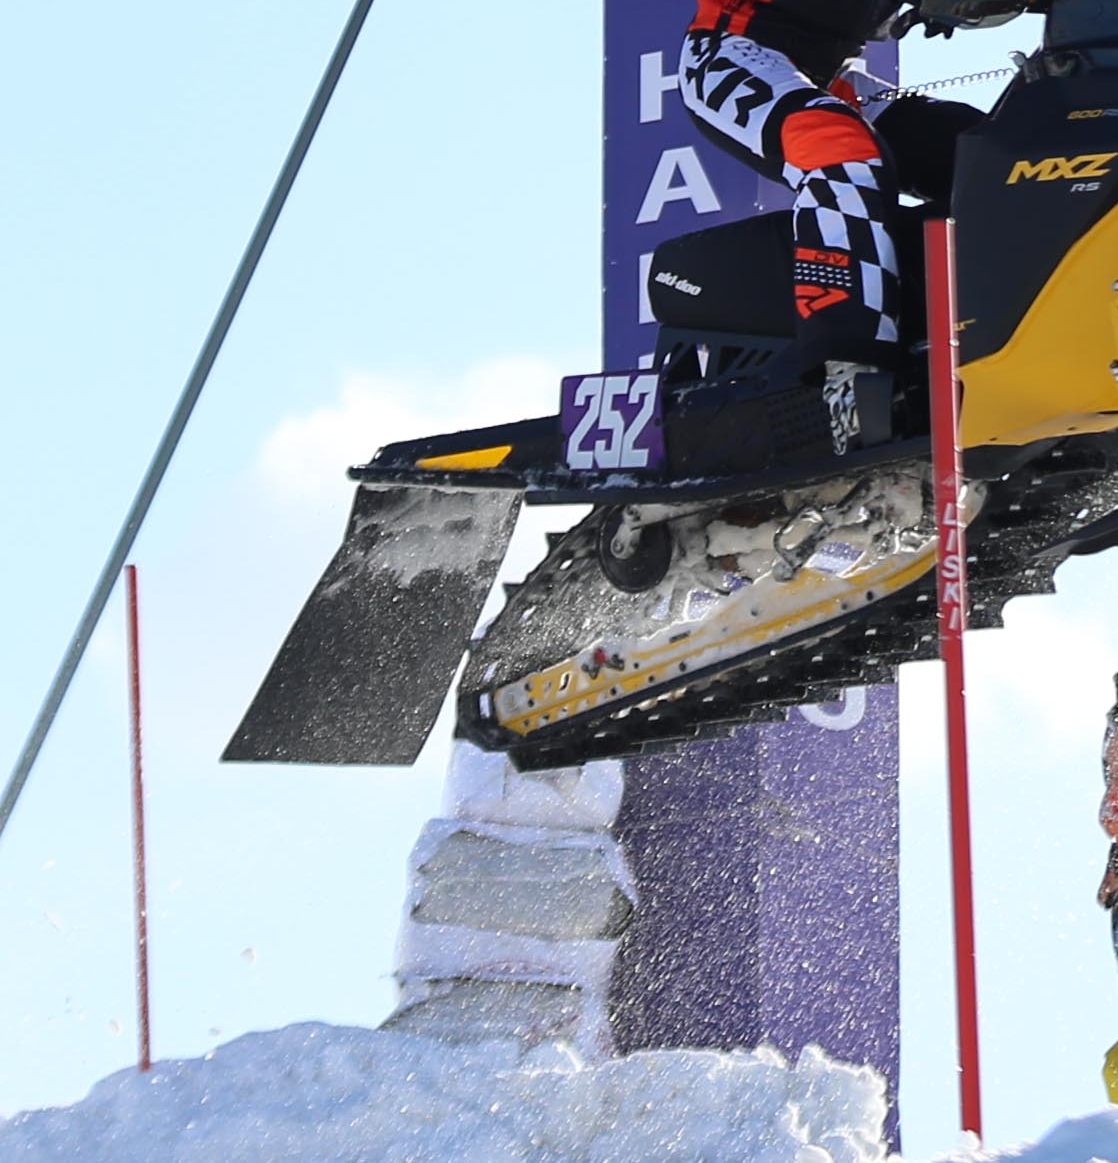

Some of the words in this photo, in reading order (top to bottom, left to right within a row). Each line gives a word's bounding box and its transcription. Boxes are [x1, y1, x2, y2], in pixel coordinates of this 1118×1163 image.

[1069, 181, 1102, 193] RS
[655, 272, 702, 296] ski-doo
[566, 375, 659, 470] 252
[942, 502, 962, 630] LISKI
